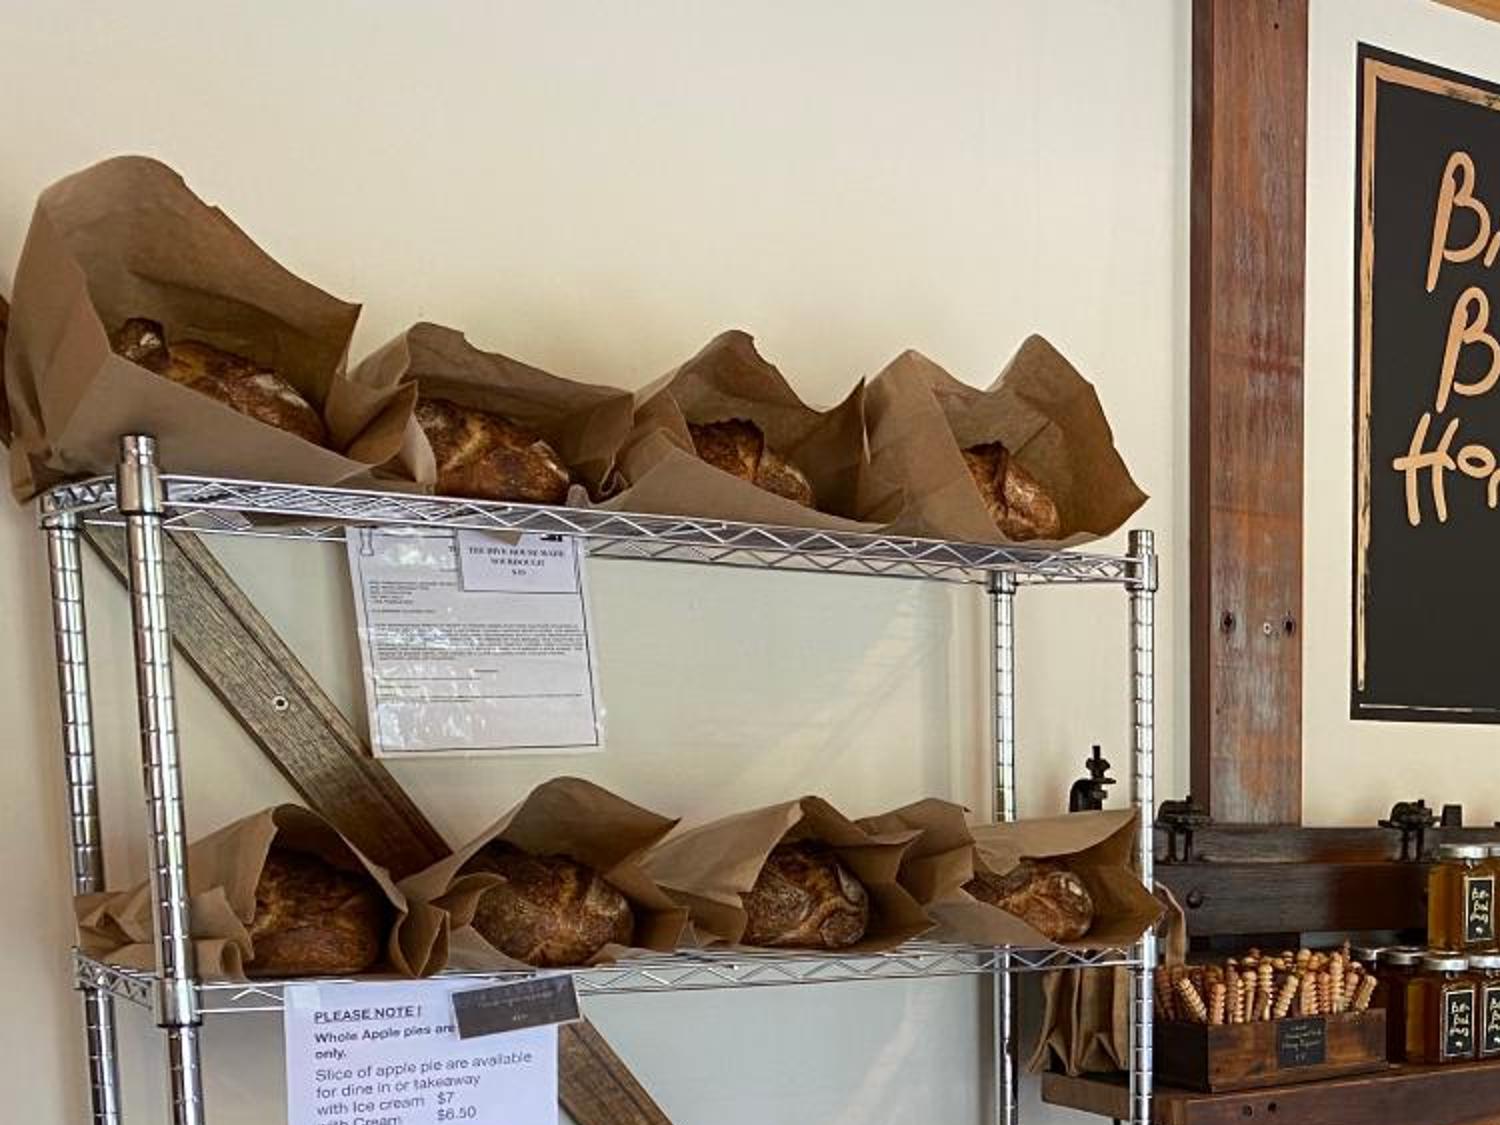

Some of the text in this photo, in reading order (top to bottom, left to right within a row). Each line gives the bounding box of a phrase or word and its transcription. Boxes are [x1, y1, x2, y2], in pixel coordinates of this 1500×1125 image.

[314, 1008, 374, 1023] PLEASE
[314, 1032, 357, 1044] Whole
[362, 1027, 400, 1042] Apple
[404, 1026, 431, 1039] pies
[315, 1048, 346, 1060] only.
[316, 1051, 532, 1082] Slice of apple pie are available
[316, 1074, 480, 1099] for dine in or takeaway
[317, 1102, 348, 1116] with
[353, 1100, 375, 1112] Ice
[379, 1097, 425, 1110] cream
